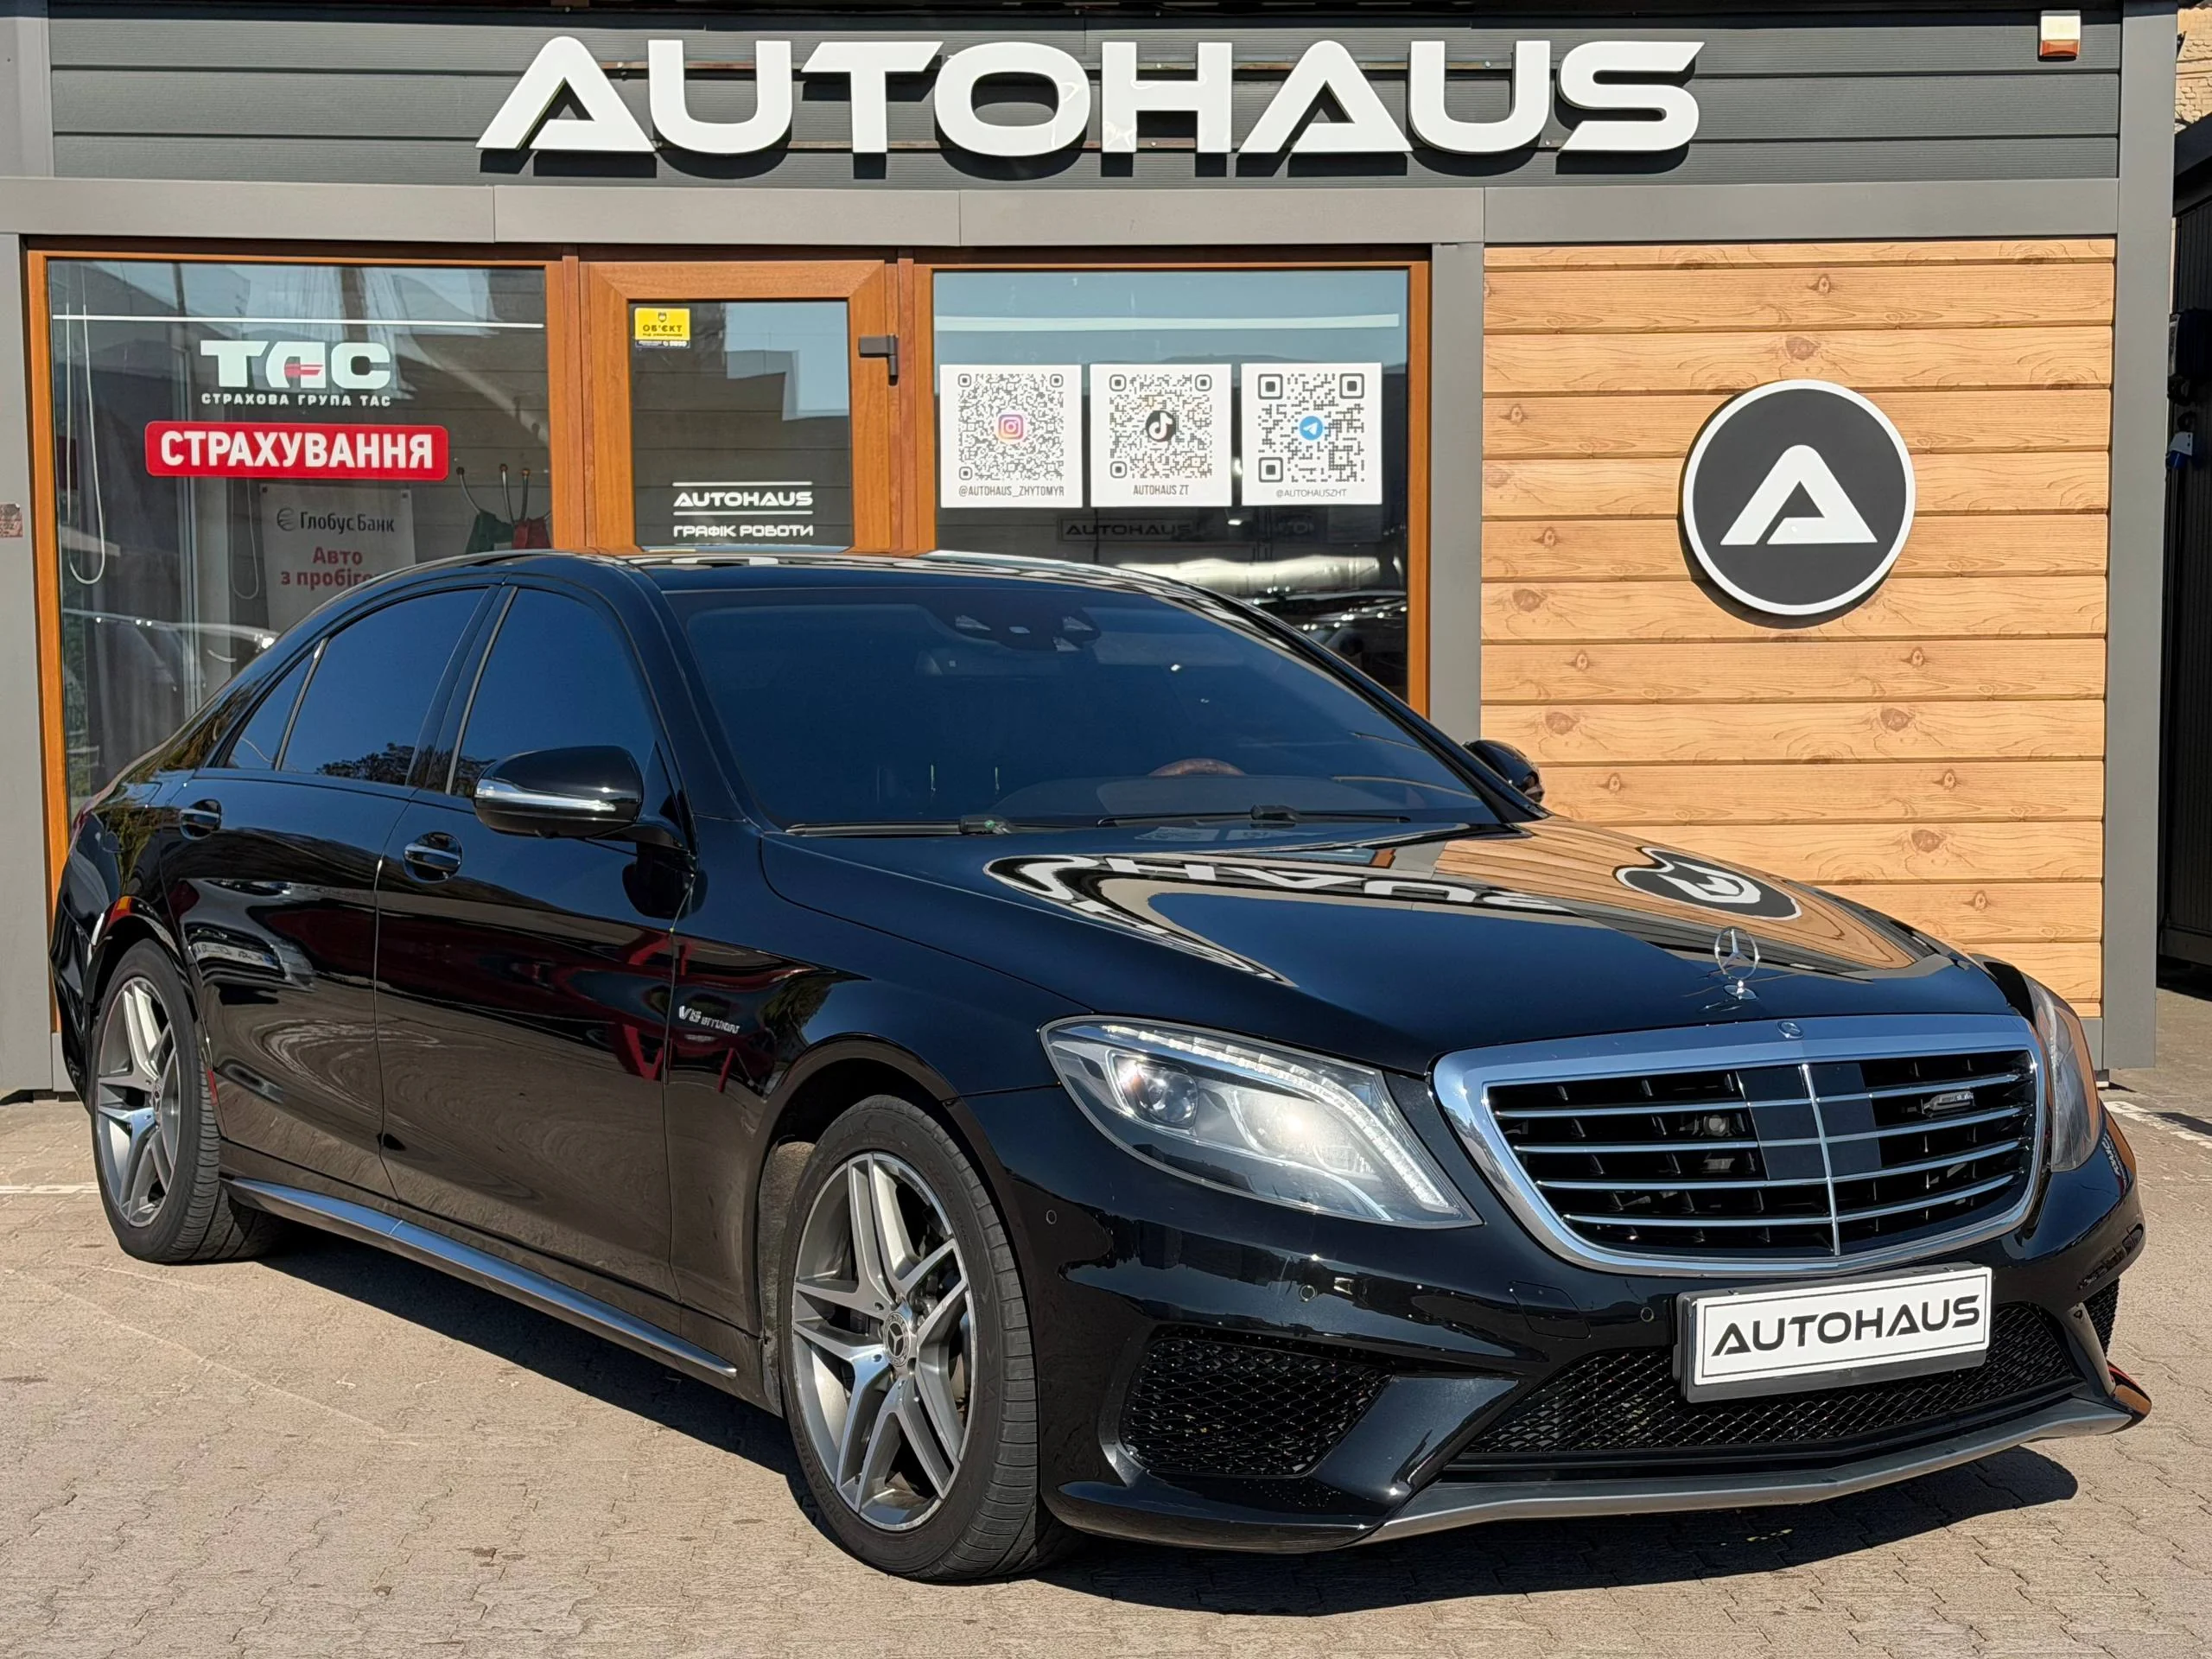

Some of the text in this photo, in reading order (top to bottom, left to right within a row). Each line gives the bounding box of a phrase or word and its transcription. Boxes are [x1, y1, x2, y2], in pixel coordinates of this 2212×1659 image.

[475, 36, 1705, 156] AUTOHAUS
[201, 393, 391, 407] СТРАХОВА ГРУПА ТАС
[161, 430, 433, 469] СТРАХУВАННЯ
[958, 486, 1065, 498] @AUTOHAUS_ZHYTOMYR
[1133, 485, 1190, 496] AUTOHAUS ZT
[673, 492, 814, 507] AUTOHAUS
[673, 524, 814, 537] ГРАФІК РОБОТИ
[312, 546, 364, 565] Авто
[281, 571, 291, 585] з
[1711, 1294, 1981, 1357] AUTOHAUS
